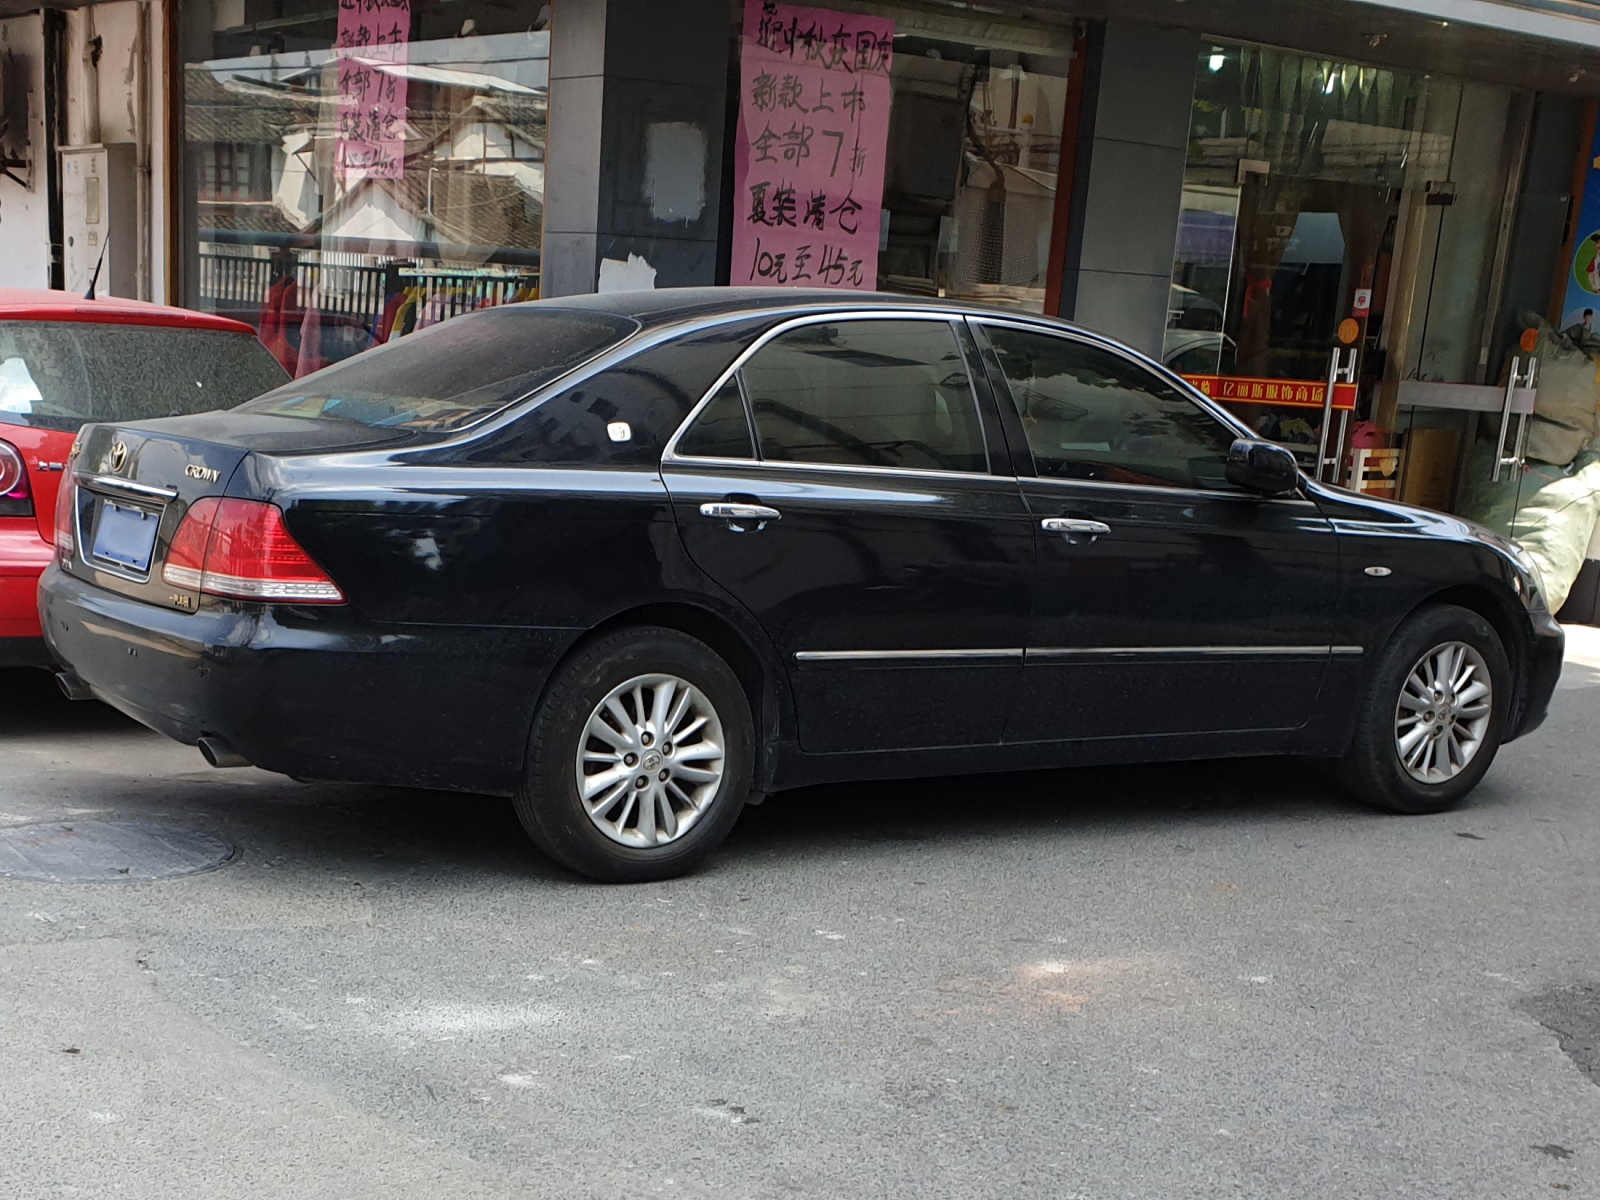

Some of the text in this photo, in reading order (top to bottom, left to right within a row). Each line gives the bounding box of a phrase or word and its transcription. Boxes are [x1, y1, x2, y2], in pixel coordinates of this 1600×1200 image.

[752, 68, 867, 122] 新款上市
[747, 178, 863, 235] 夏装清仓
[750, 237, 864, 287] 10元至45元
[184, 464, 221, 483] CROWN
